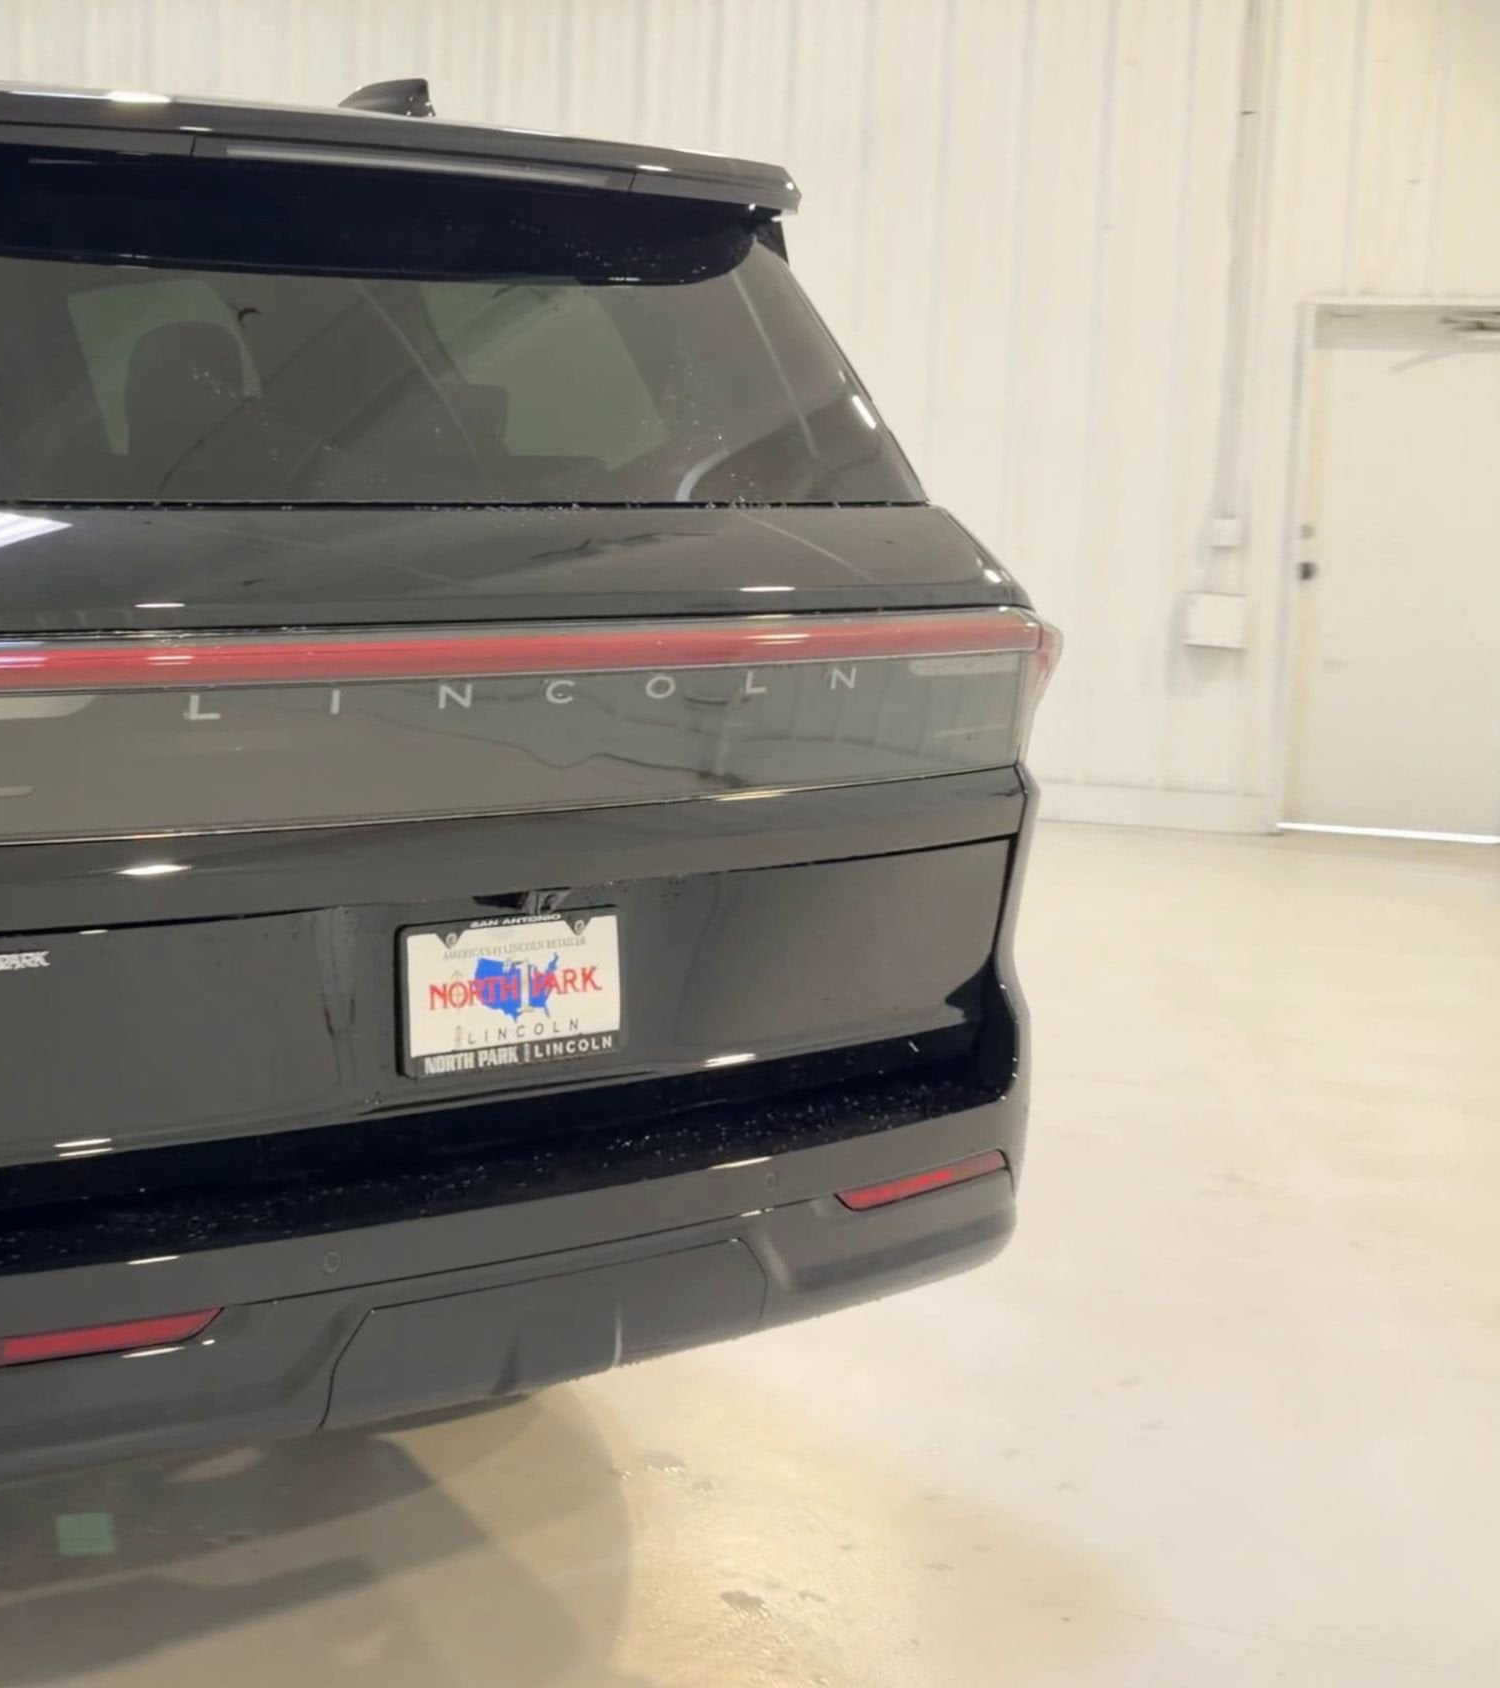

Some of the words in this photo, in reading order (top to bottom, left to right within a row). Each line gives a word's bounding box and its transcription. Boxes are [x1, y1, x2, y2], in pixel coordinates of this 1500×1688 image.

[184, 667, 856, 720] LINCOLN
[470, 919, 498, 929] SAN
[502, 913, 562, 925] ANTONIO
[503, 940, 544, 953] LINCOLN
[429, 975, 521, 1010] NORTH
[532, 966, 602, 998] PARK
[467, 1019, 579, 1045] LINCOLN
[424, 1050, 475, 1075] NORTH
[478, 1046, 519, 1067] PARK
[534, 1036, 612, 1058] LINCOLN
